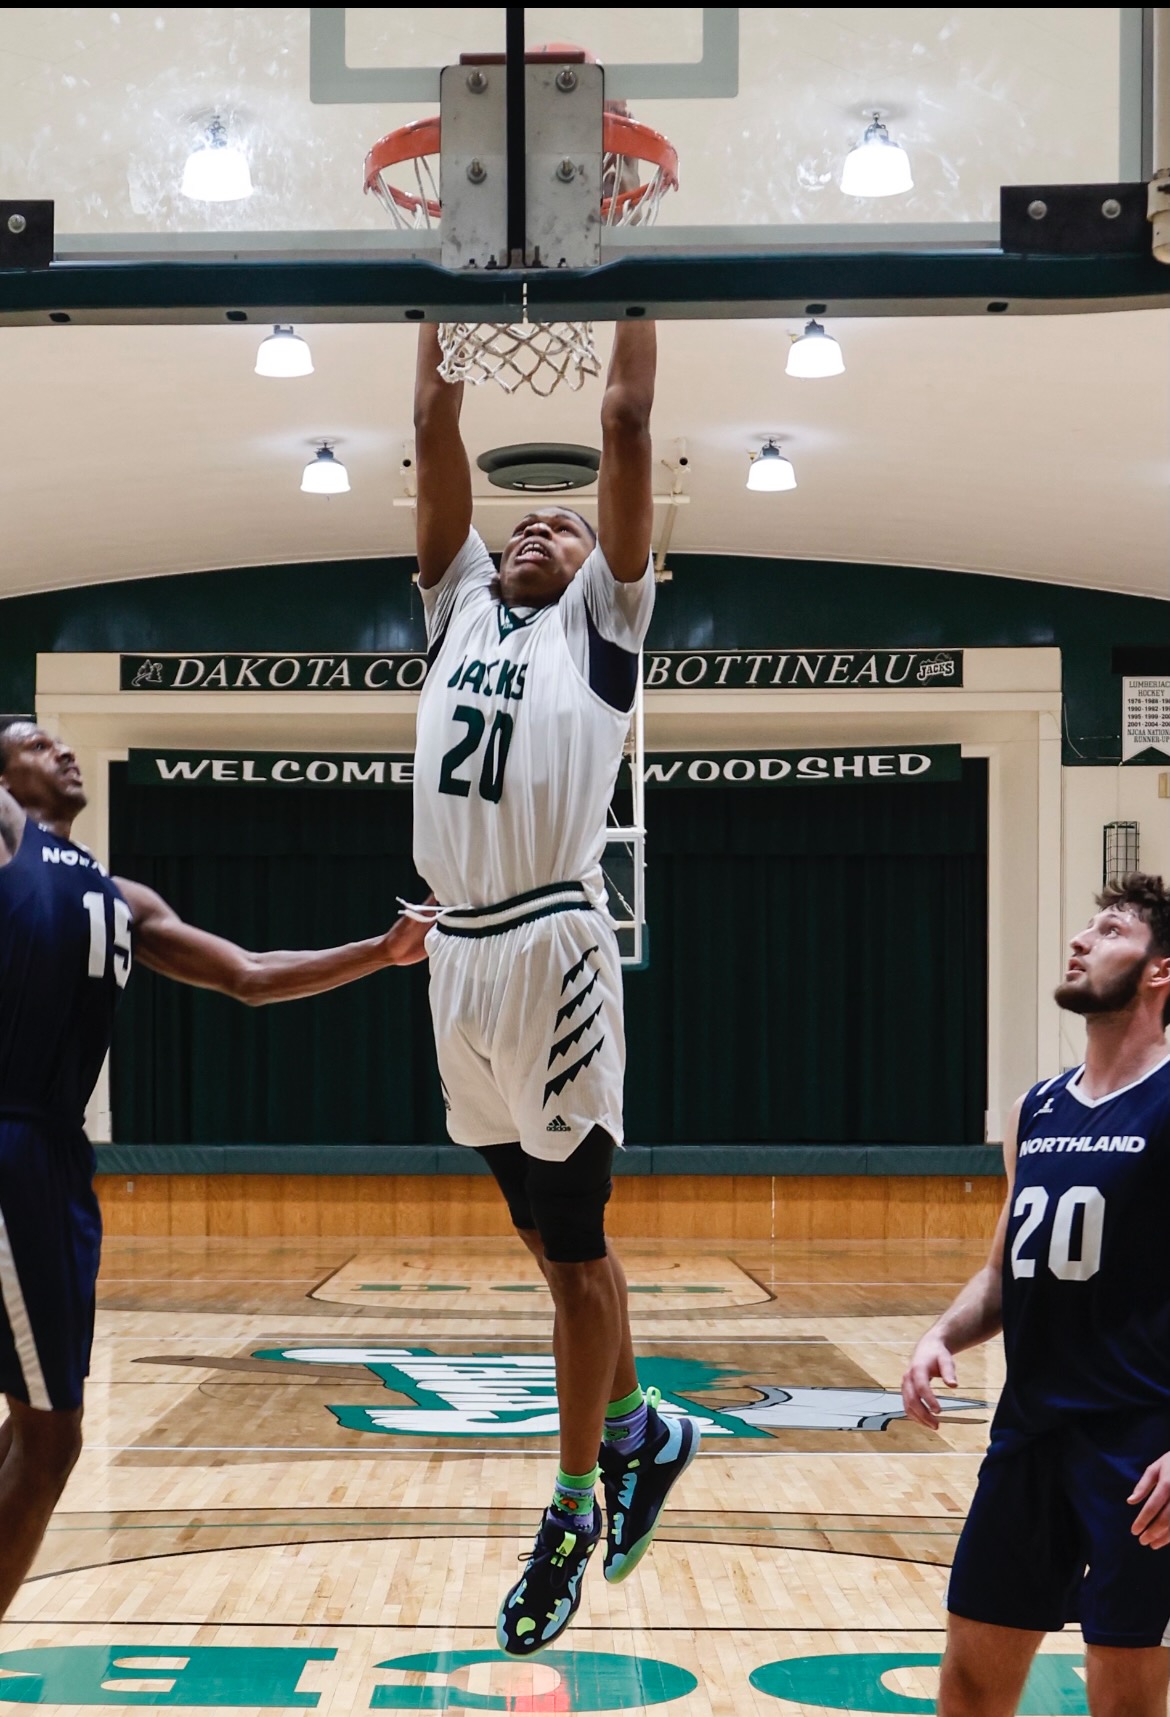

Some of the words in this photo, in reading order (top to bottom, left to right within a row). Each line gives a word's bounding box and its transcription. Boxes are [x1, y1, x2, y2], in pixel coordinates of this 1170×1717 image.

[169, 658, 351, 687] DAKOTA
[364, 658, 428, 687] CO
[644, 653, 917, 685] BOTTINEAU
[447, 654, 530, 700] JACKS
[916, 661, 955, 681] JACKS
[1138, 689, 1165, 697] HOCKEY
[155, 758, 414, 783] WELCOME
[628, 753, 932, 782] WOODSHED
[438, 704, 514, 805] 20
[82, 891, 133, 990] 15
[1019, 1136, 1146, 1158] NORTHLAND
[1010, 1185, 1106, 1282] 20
